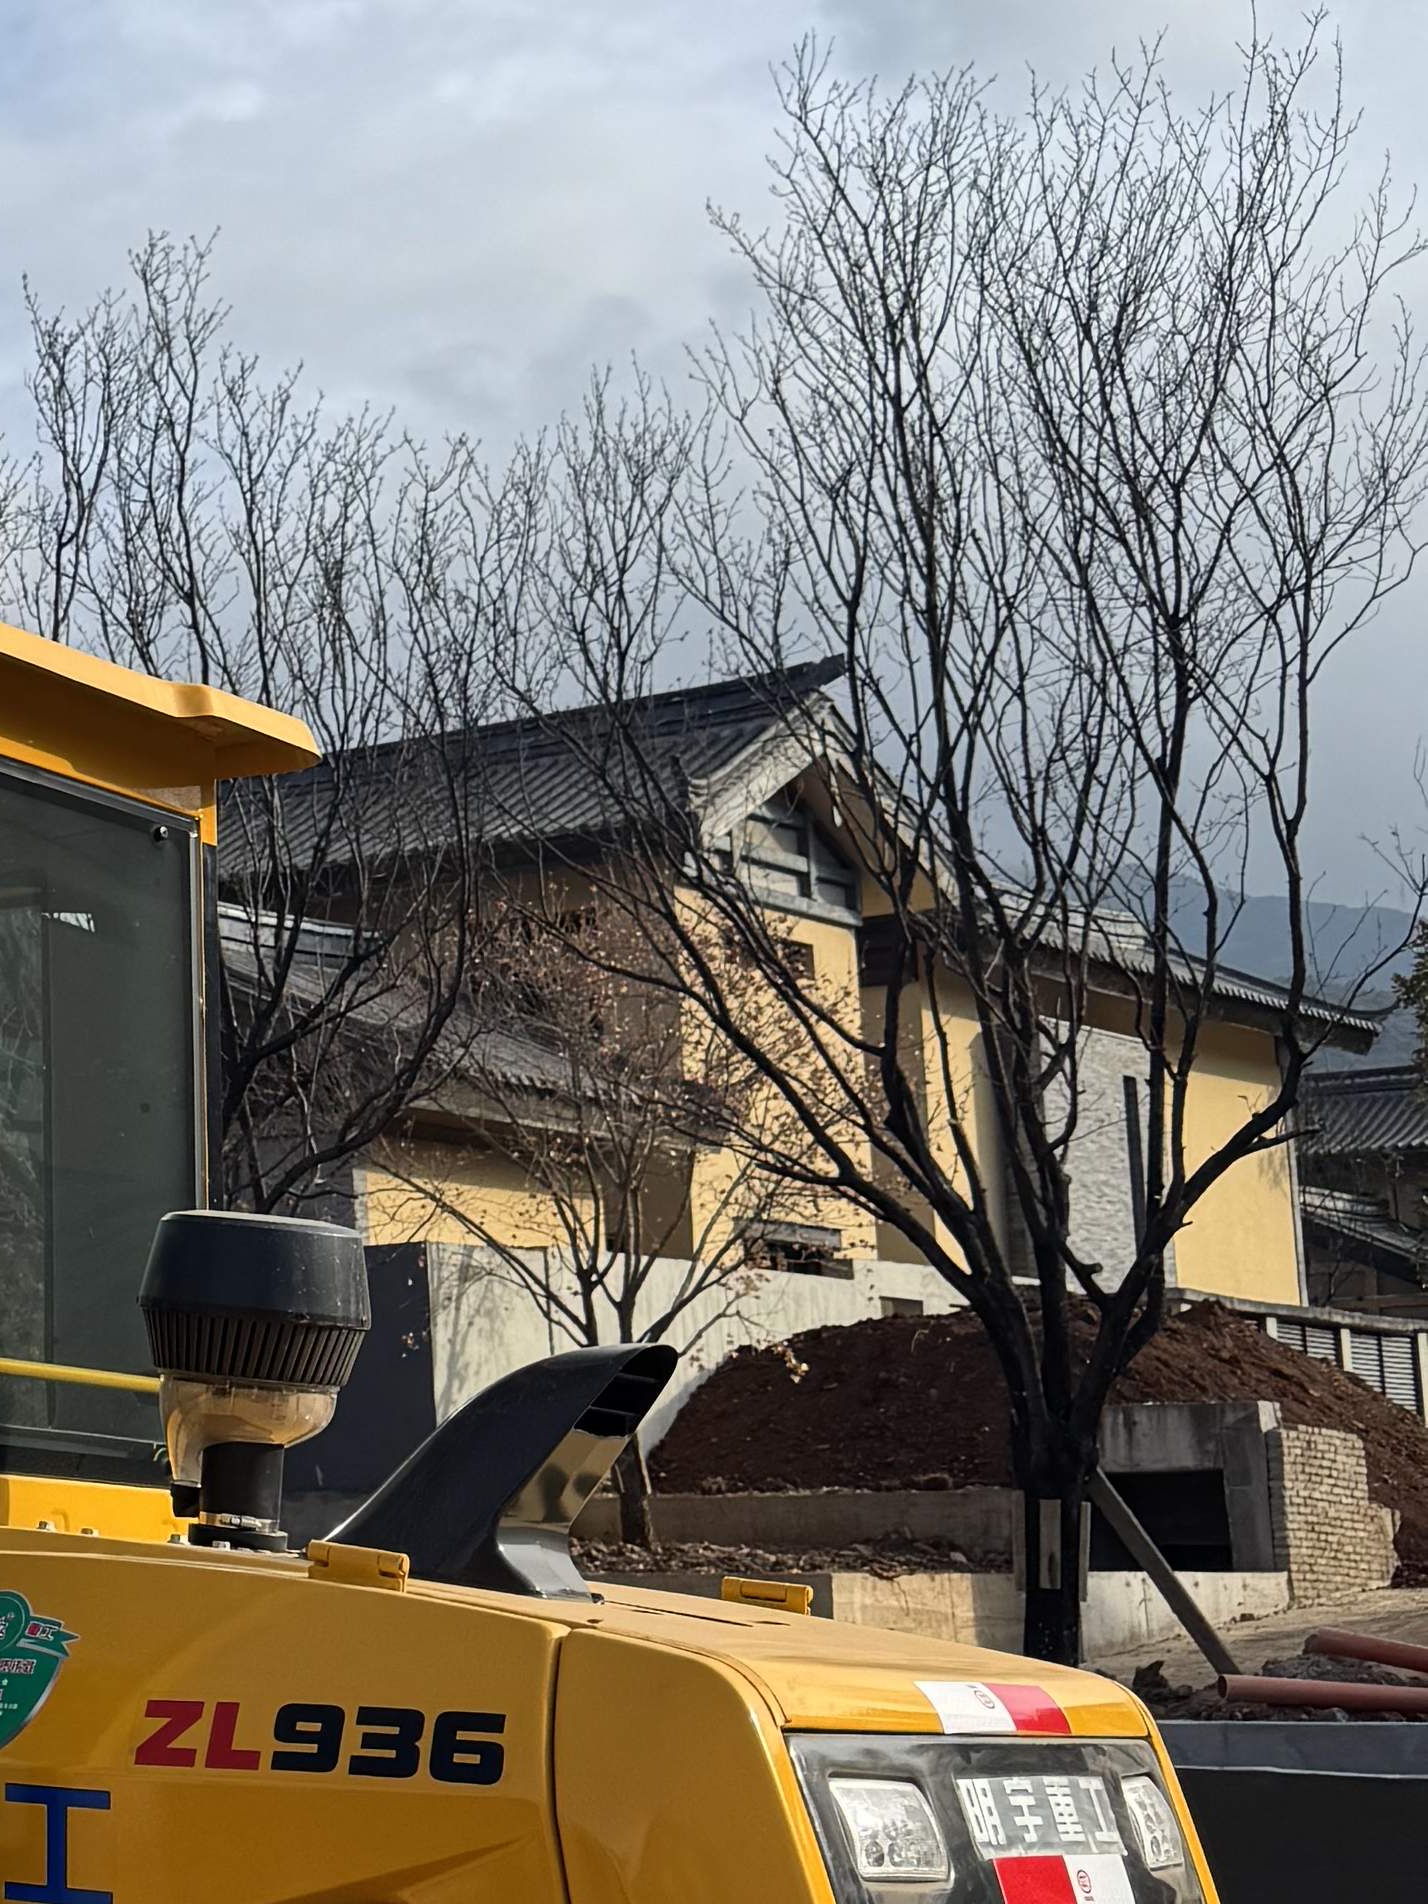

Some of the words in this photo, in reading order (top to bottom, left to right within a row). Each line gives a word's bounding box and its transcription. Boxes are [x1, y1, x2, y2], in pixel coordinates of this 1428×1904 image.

[134, 1700, 506, 1785] ZL936
[957, 1776, 1120, 1845] 明宇重工
